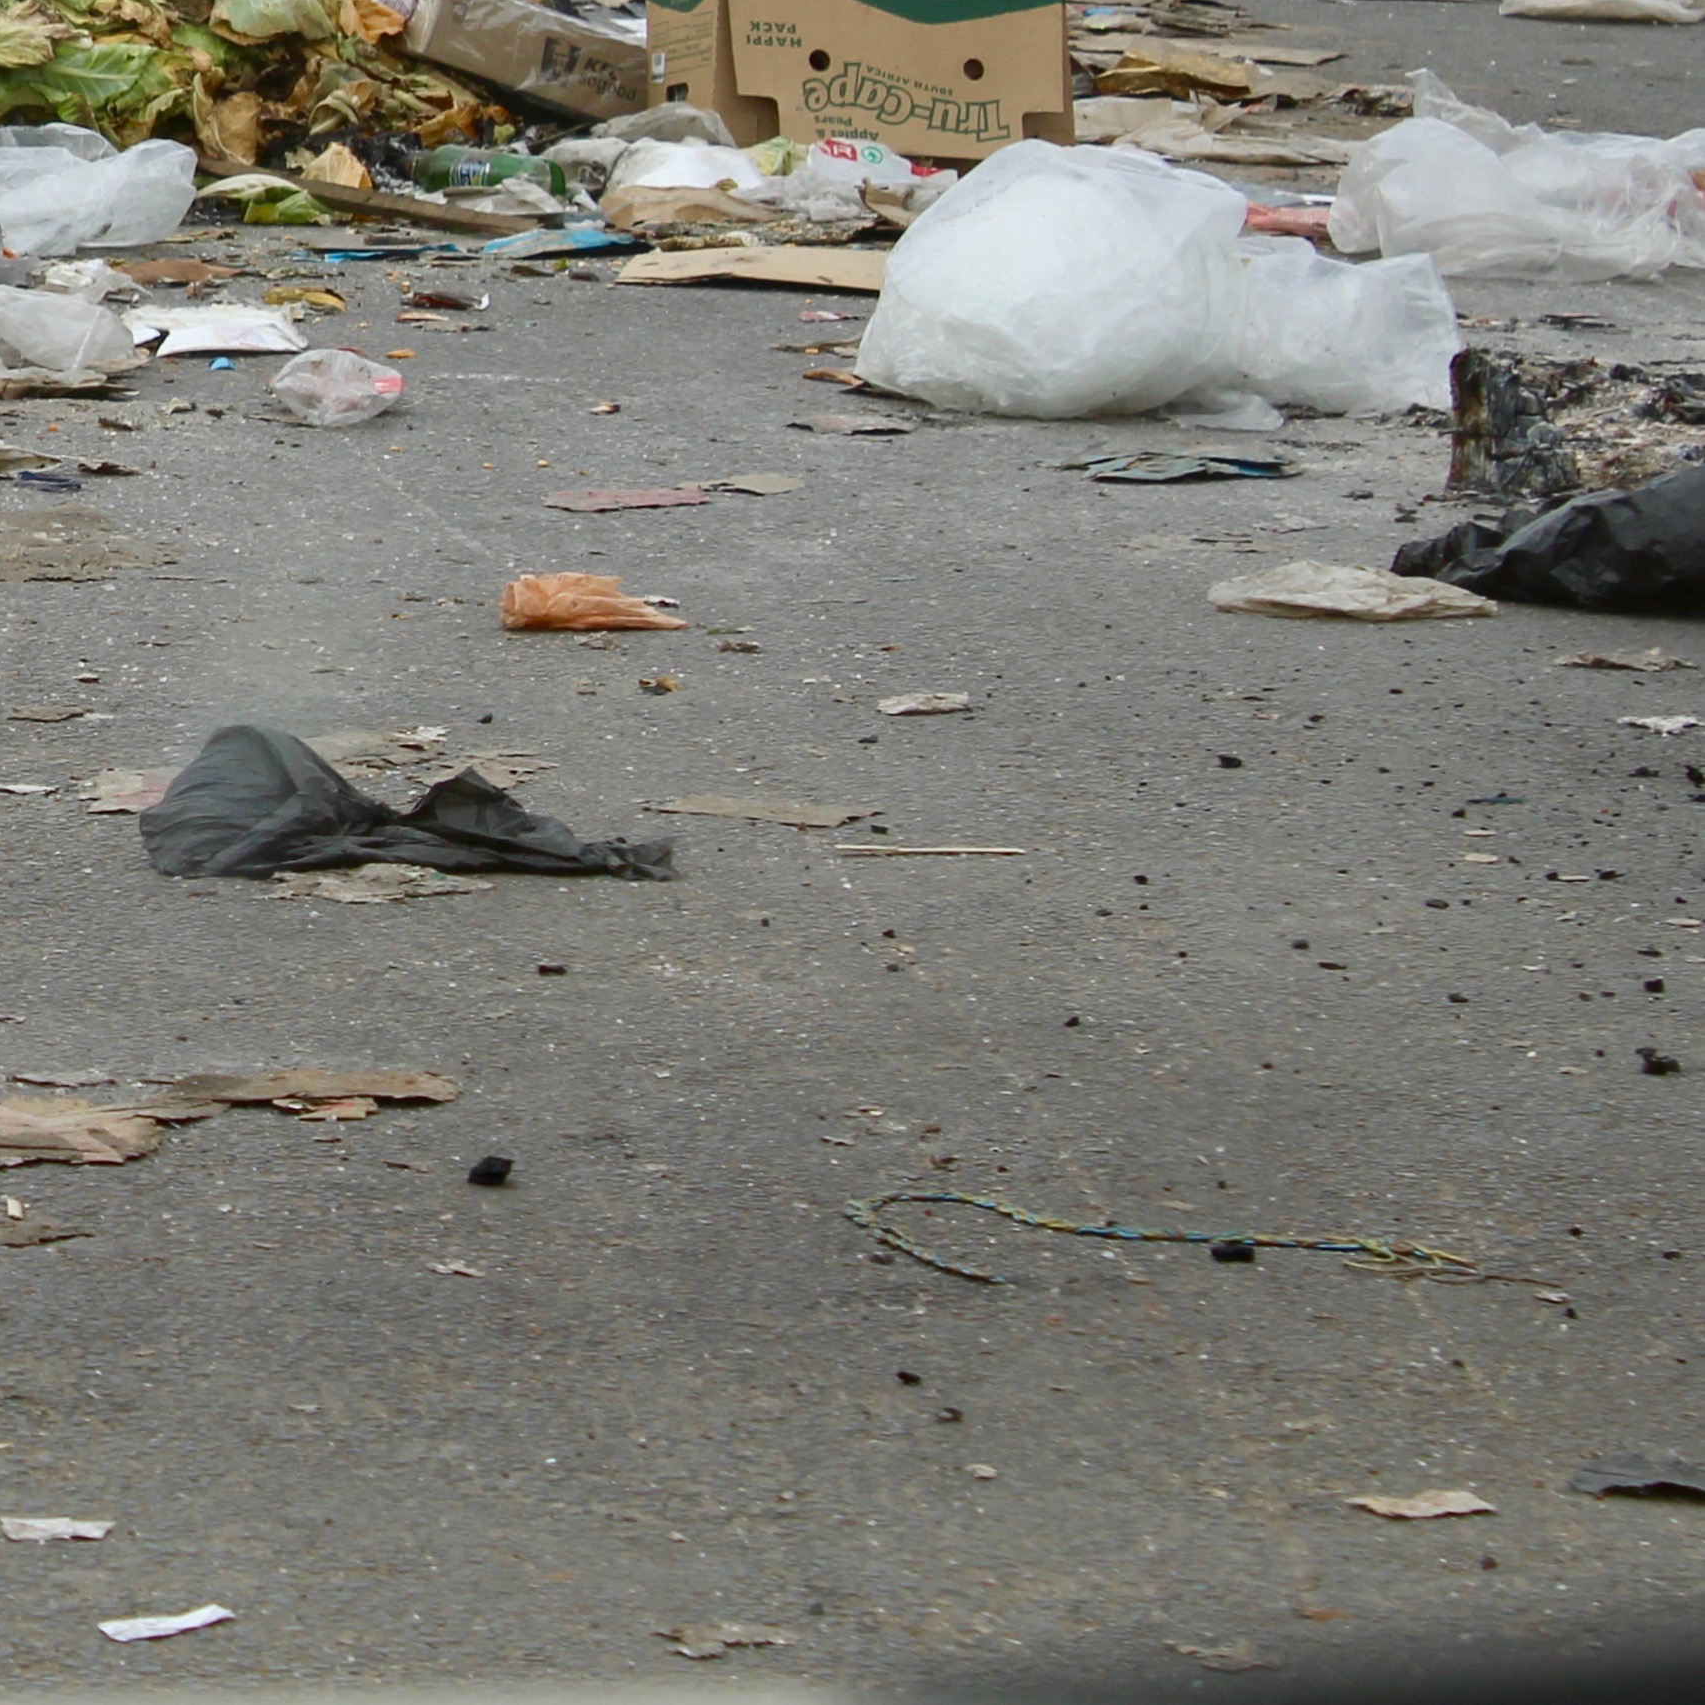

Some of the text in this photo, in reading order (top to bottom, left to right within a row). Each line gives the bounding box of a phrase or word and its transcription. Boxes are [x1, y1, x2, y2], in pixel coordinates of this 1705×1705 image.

[749, 20, 796, 34] PACK
[746, 34, 802, 48] HAPPI
[583, 57, 624, 81] KFC
[866, 64, 954, 96] SOUTH AFRICA
[802, 62, 1011, 143] Tru-Cape
[814, 114, 853, 127] Pears
[815, 128, 879, 141] Apples &
